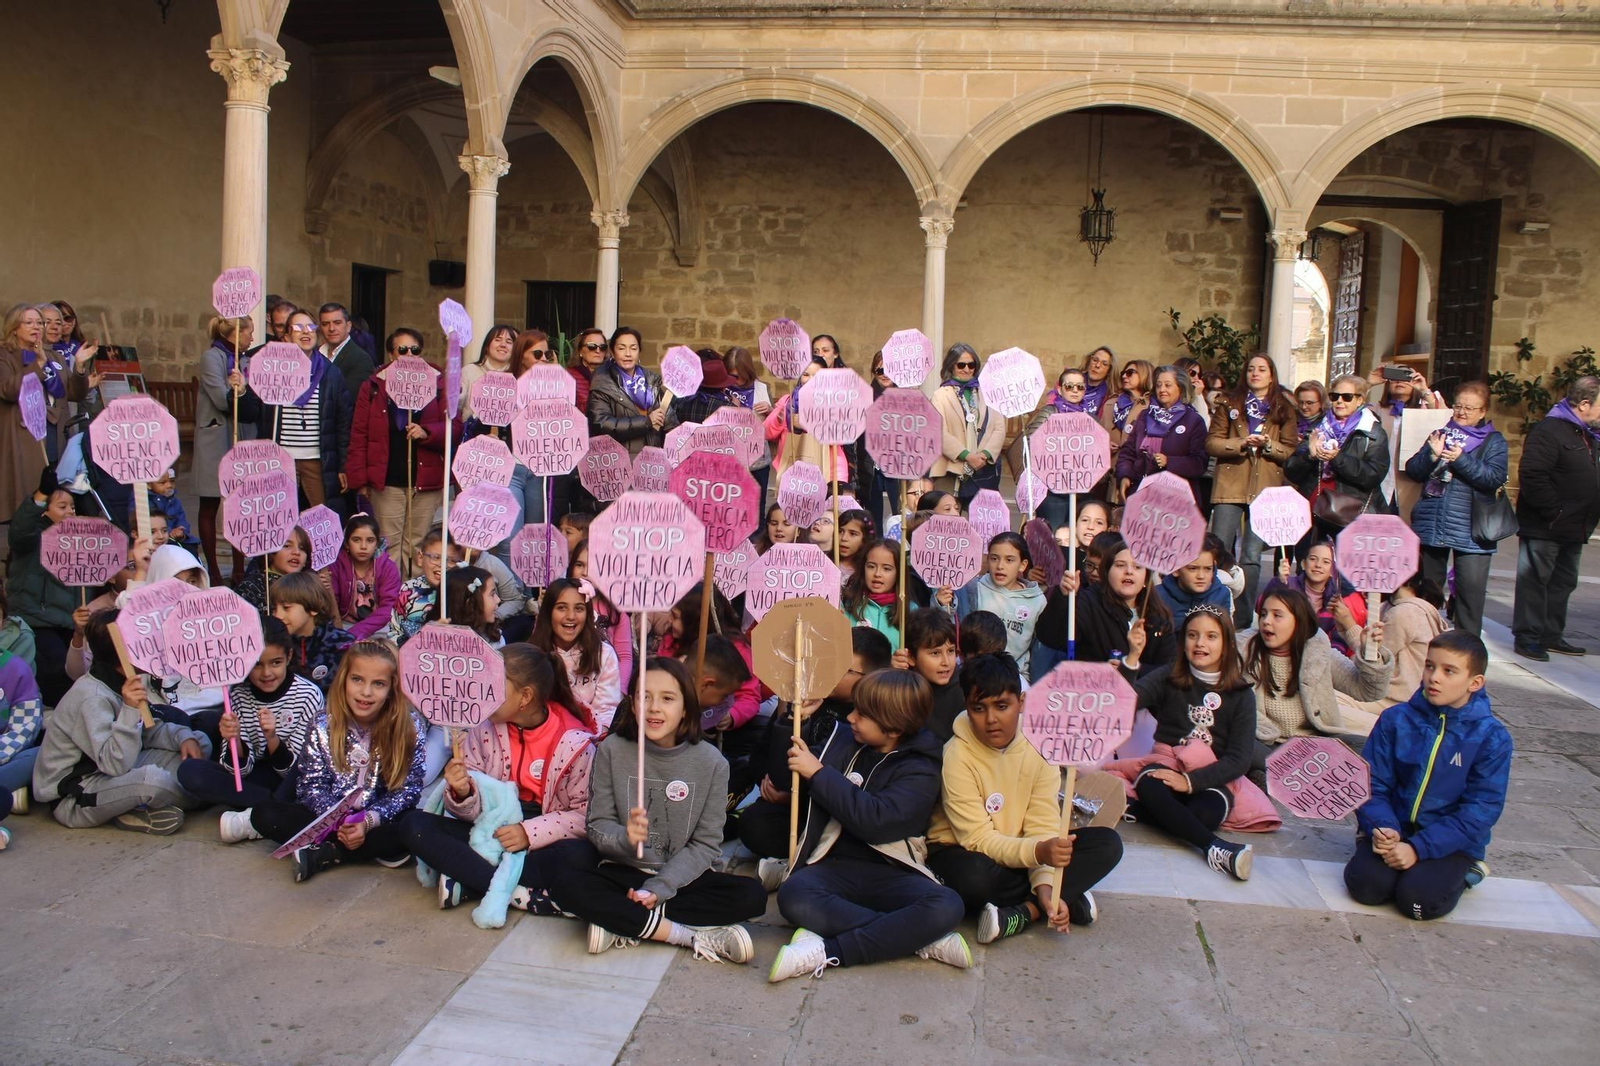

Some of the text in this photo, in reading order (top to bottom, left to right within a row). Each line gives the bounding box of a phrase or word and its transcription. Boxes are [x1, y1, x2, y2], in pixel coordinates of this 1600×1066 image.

[222, 280, 252, 293] STOP
[216, 292, 257, 306] VIOLENCIA
[770, 336, 801, 350] STOP
[893, 344, 923, 359] STOP
[762, 350, 807, 362] VIOLENCIA
[886, 356, 931, 373] VIOLENCIA
[262, 359, 301, 374] STOP
[395, 371, 428, 382] STOP
[992, 364, 1031, 386] STOP
[252, 373, 306, 387] VIOLENCIA
[388, 382, 432, 396] VIOLENCIA
[529, 379, 566, 394] STOP
[481, 386, 515, 399] STOP
[812, 388, 859, 406] STOP
[987, 377, 1041, 404] VIOLENCIA
[473, 397, 518, 413] VIOLENCIA
[106, 421, 162, 441] STOP
[526, 419, 574, 437] STOP
[880, 412, 928, 434] STOP
[96, 441, 173, 461] VIOLENCIA
[516, 437, 582, 456] VIOLENCIA
[869, 432, 935, 456] VIOLENCIA
[1045, 434, 1096, 453] STOP
[233, 459, 282, 477] STOP
[467, 450, 505, 468] STOP
[586, 453, 619, 469] STOP
[1034, 453, 1105, 472] VIOLENCIA
[457, 460, 506, 486] VIOLENCIA
[582, 467, 631, 486] VIOLENCIA
[639, 462, 666, 477] STOP
[684, 477, 742, 505] STOP
[789, 477, 819, 496] STOP
[240, 491, 287, 516] STOP
[465, 498, 507, 517] STOP
[611, 499, 641, 523] JUAN
[780, 490, 821, 514] VIOLENCIA
[1261, 503, 1300, 517] STOP
[228, 508, 294, 537] VIOLENCIA
[451, 511, 507, 536] VIOLENCIA
[977, 506, 1003, 522] STOP
[1140, 503, 1191, 534] STOP
[1253, 515, 1306, 533] VIOLENCIA
[309, 519, 332, 539] TOP
[612, 525, 686, 552] STOP
[1126, 518, 1194, 557] VIOLENCIA
[58, 536, 113, 551] STOP
[314, 530, 341, 552] ENCIA
[925, 533, 971, 553] STOP
[1353, 534, 1405, 553] STOP
[46, 551, 120, 567] VIOLENCIA
[594, 553, 694, 578] VIOLENCIA
[763, 548, 788, 568] JUAN
[914, 549, 977, 571] VIOLENCIA
[1341, 550, 1411, 571] VIOLENCIA
[714, 564, 748, 584] ENCIA
[764, 568, 825, 591] STOP
[176, 600, 202, 621] JUAN
[181, 614, 242, 641] STOP
[170, 634, 257, 666] VIOLENCIA
[416, 631, 485, 656] JUAN PASQUAU
[419, 653, 485, 679] STOP
[405, 673, 496, 702] VIOLENCIA
[1046, 690, 1117, 714] STOP
[1029, 713, 1122, 737] VIOLENCIA
[1282, 751, 1331, 792] STOP
[1288, 760, 1362, 813] VIOLENCIA
